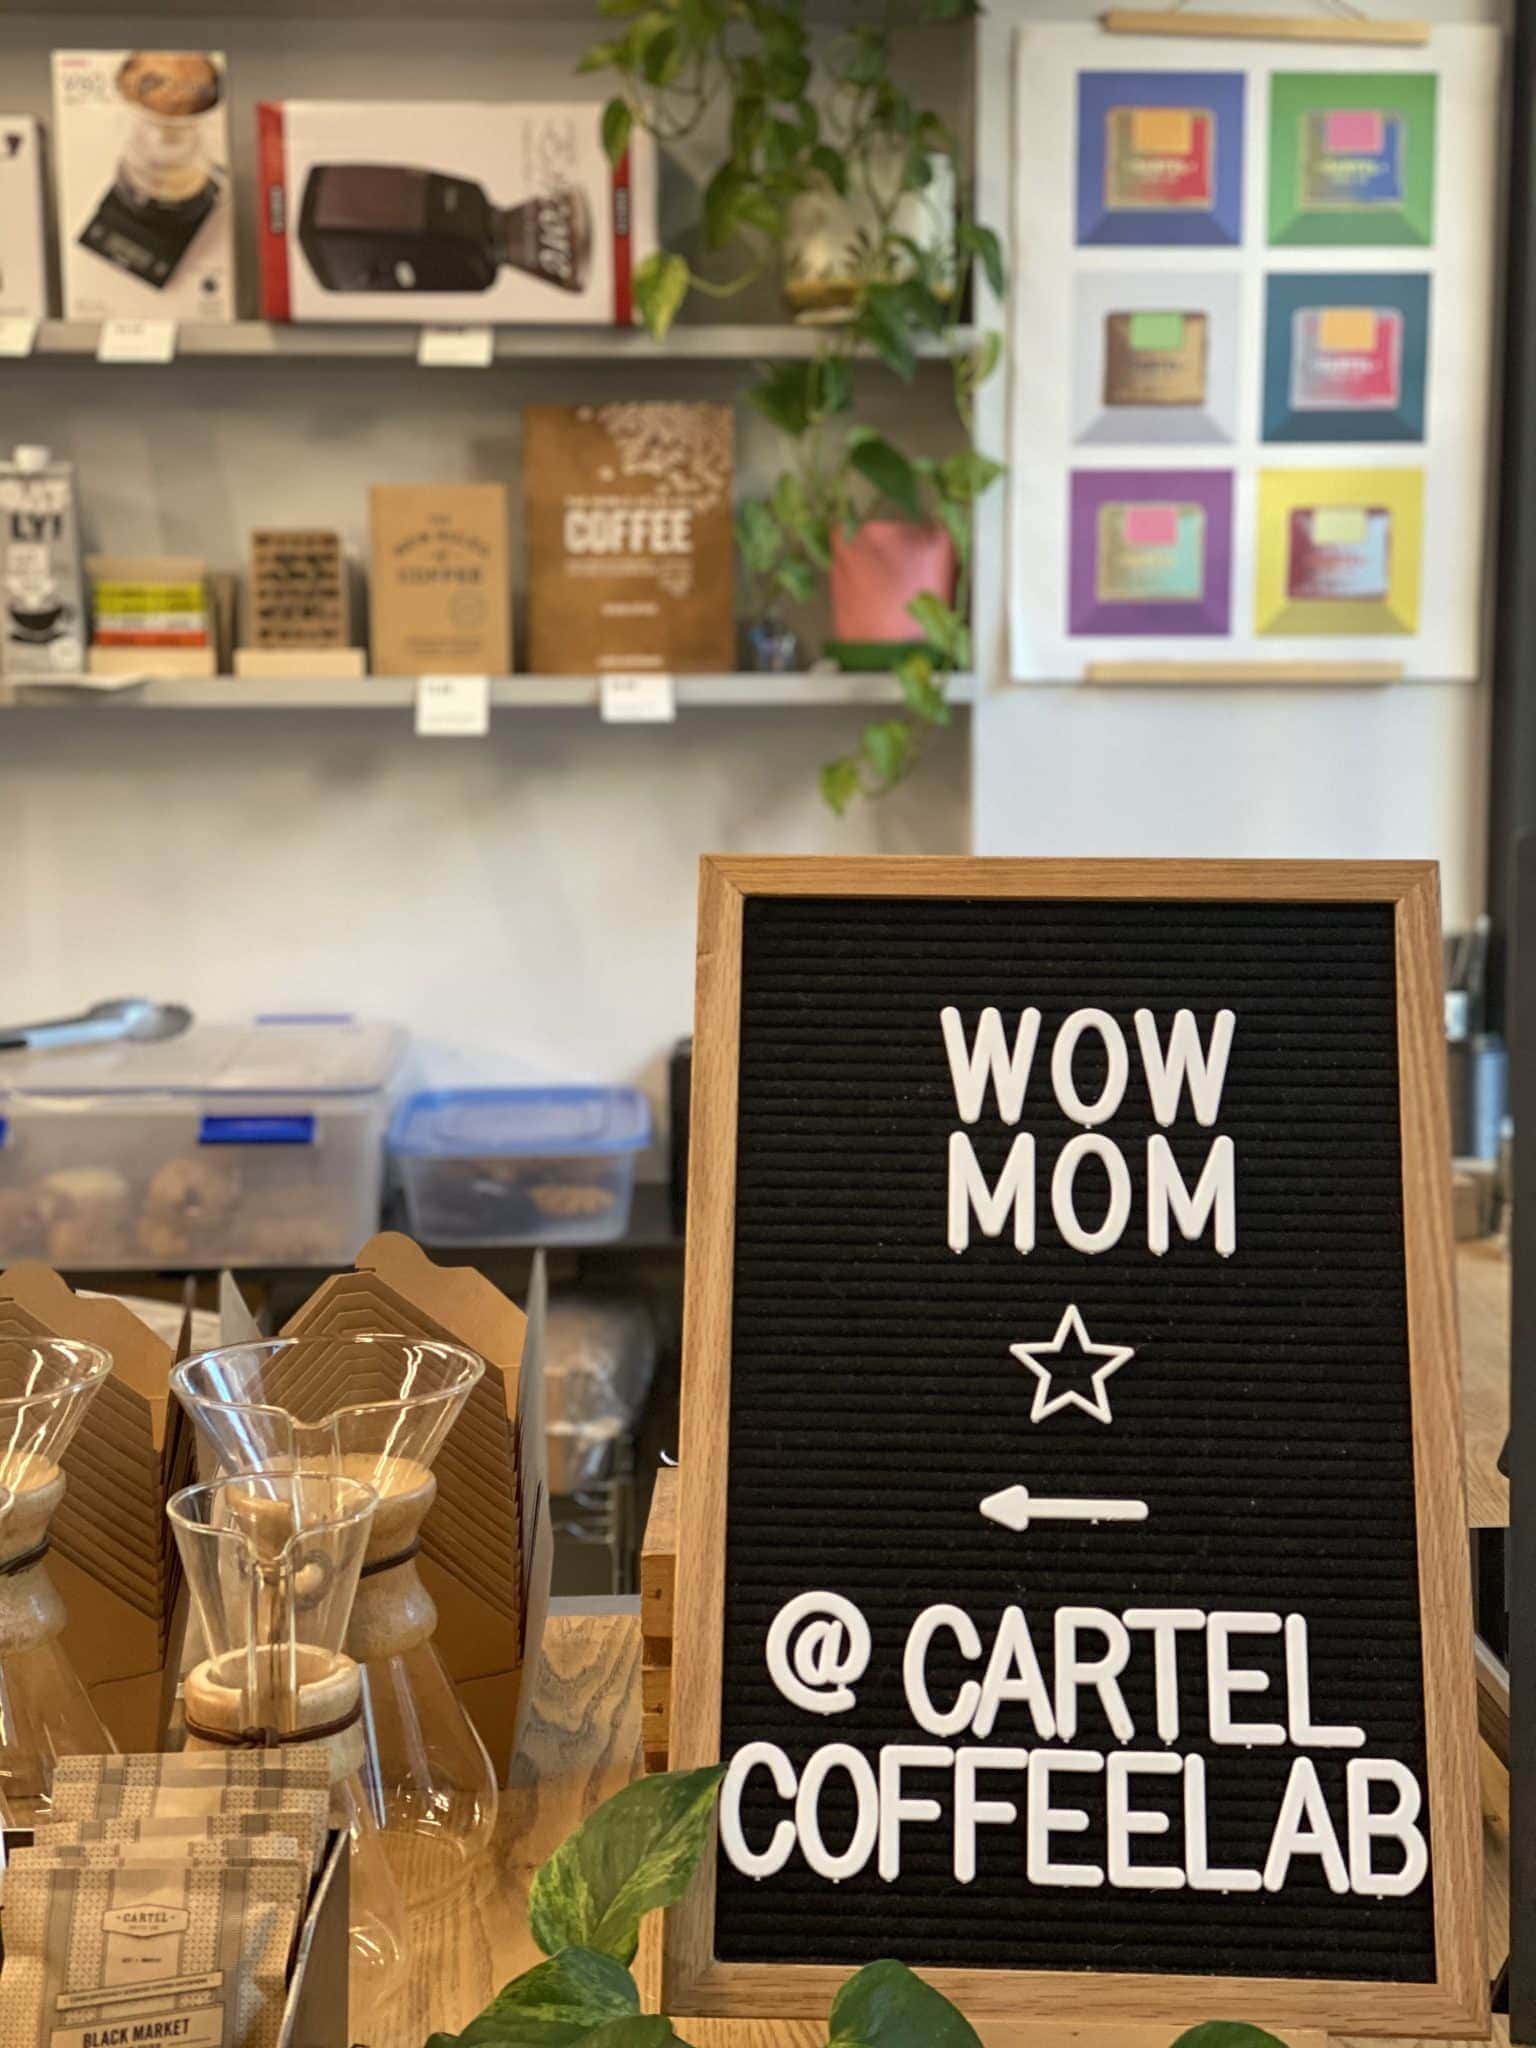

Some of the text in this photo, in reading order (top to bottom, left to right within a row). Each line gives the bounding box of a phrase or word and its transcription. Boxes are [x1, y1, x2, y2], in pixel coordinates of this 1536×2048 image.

[563, 509, 694, 554] COFFEE
[940, 1006, 1236, 1128] WOW
[947, 1131, 1236, 1257] MOM
[765, 1590, 1366, 1748] @ CARTEL
[123, 1911, 169, 1924] CARTEL
[83, 2018, 190, 2048] BLACK MARKET
